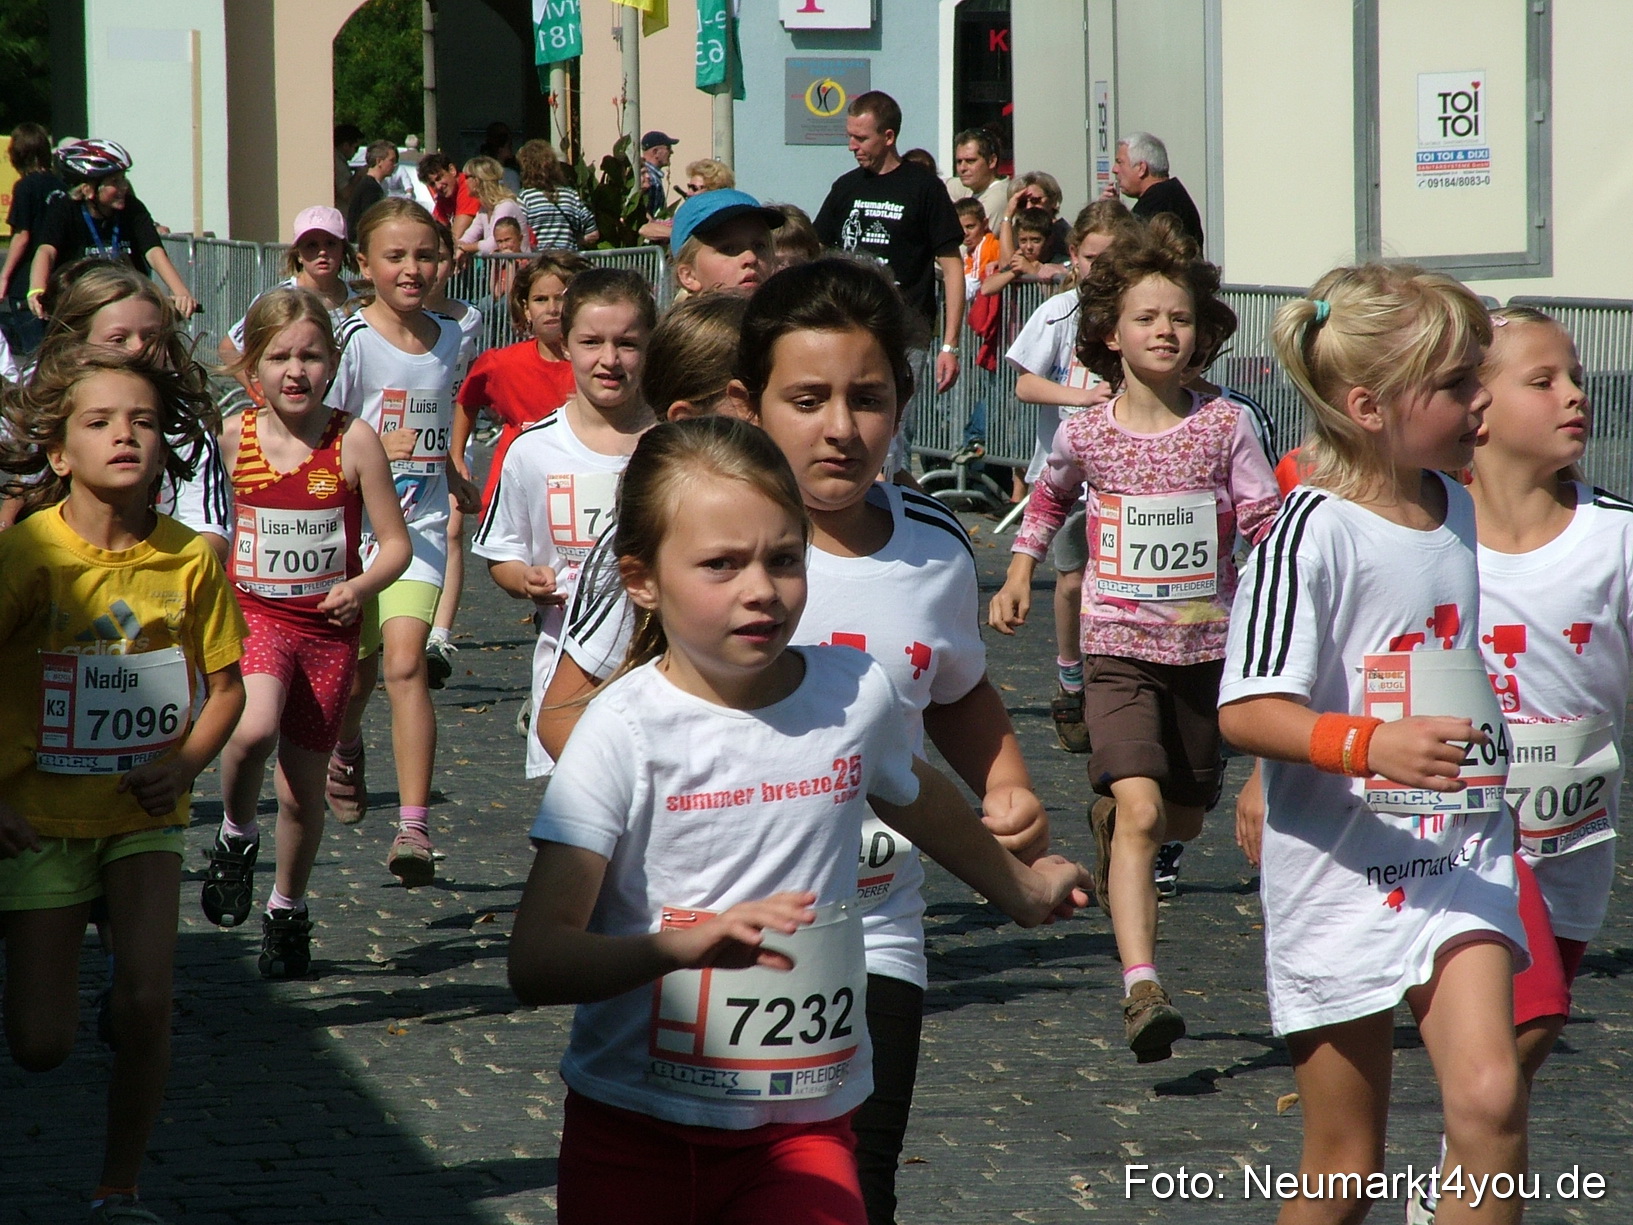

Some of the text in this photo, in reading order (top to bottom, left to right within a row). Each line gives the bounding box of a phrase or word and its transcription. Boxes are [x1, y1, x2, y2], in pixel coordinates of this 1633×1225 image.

[1438, 114, 1479, 137] TOI
[1418, 149, 1488, 162] TOI TOI & DIXI
[1427, 175, 1490, 188] 09184/8083-0
[409, 398, 437, 413] Luisa
[261, 517, 338, 535] Lisa-Marie
[1127, 506, 1194, 526] Cornelia
[239, 540, 251, 553] K3
[1102, 533, 1115, 548] K3
[265, 547, 337, 573] 7007
[1130, 540, 1209, 571] 7025
[1098, 580, 1140, 593] BOCK
[1171, 580, 1215, 592] PFLEIDERER
[85, 667, 139, 692] Nadja
[46, 699, 65, 716] K3
[87, 703, 178, 741] 7096
[666, 786, 755, 811] summer
[761, 775, 832, 803] breeze
[832, 754, 862, 790] 25
[1367, 790, 1443, 806] BOCK
[1506, 776, 1605, 822] 7002
[1366, 846, 1470, 886] neumarkt
[726, 987, 854, 1046] 7232
[652, 1060, 740, 1089] BOCK
